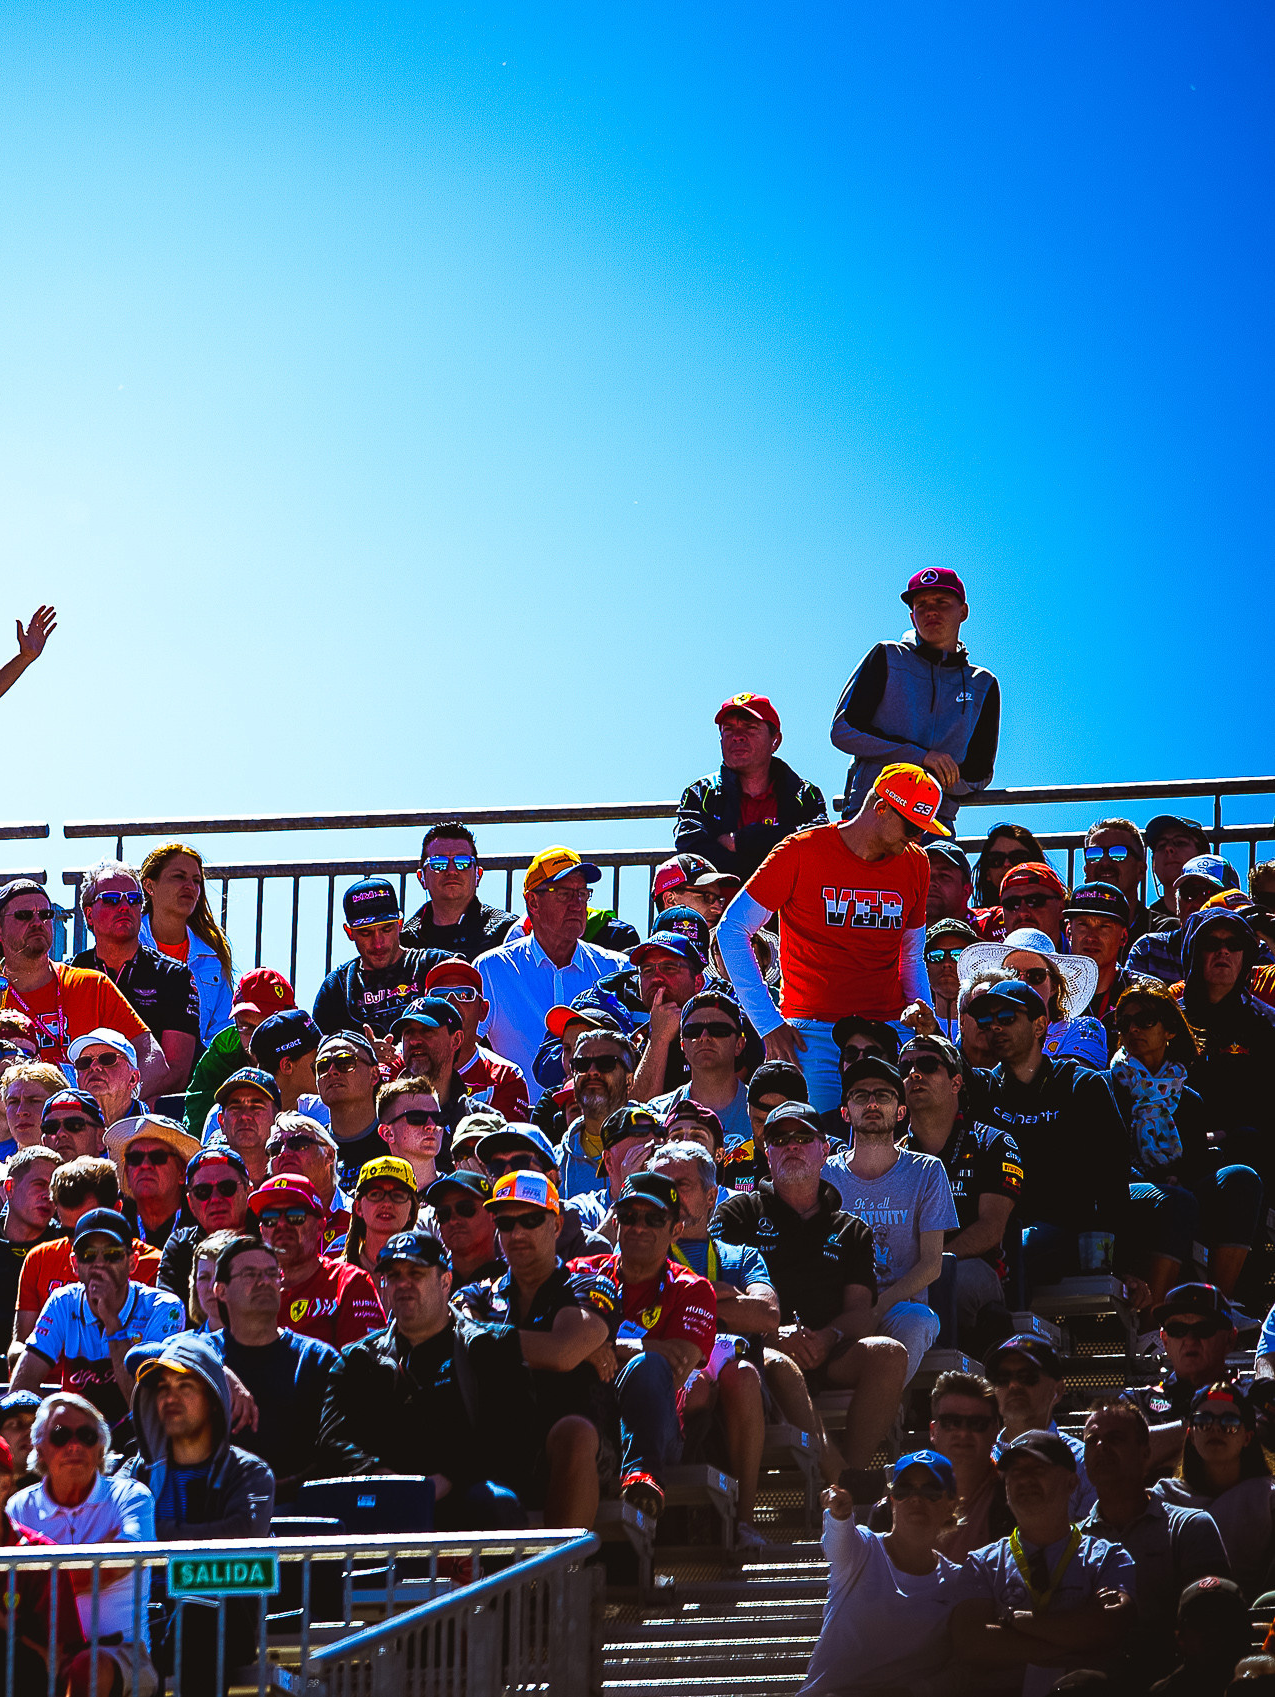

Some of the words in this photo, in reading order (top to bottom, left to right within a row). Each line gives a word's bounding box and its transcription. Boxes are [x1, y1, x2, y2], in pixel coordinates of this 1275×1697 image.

[887, 790, 907, 807] exact
[913, 803, 932, 815] 33
[822, 886, 903, 929] VER
[364, 988, 386, 1005] Bull
[877, 1196, 890, 1209] all
[848, 1210, 908, 1225] ATIVITY
[181, 1563, 265, 1585] SALIDA
